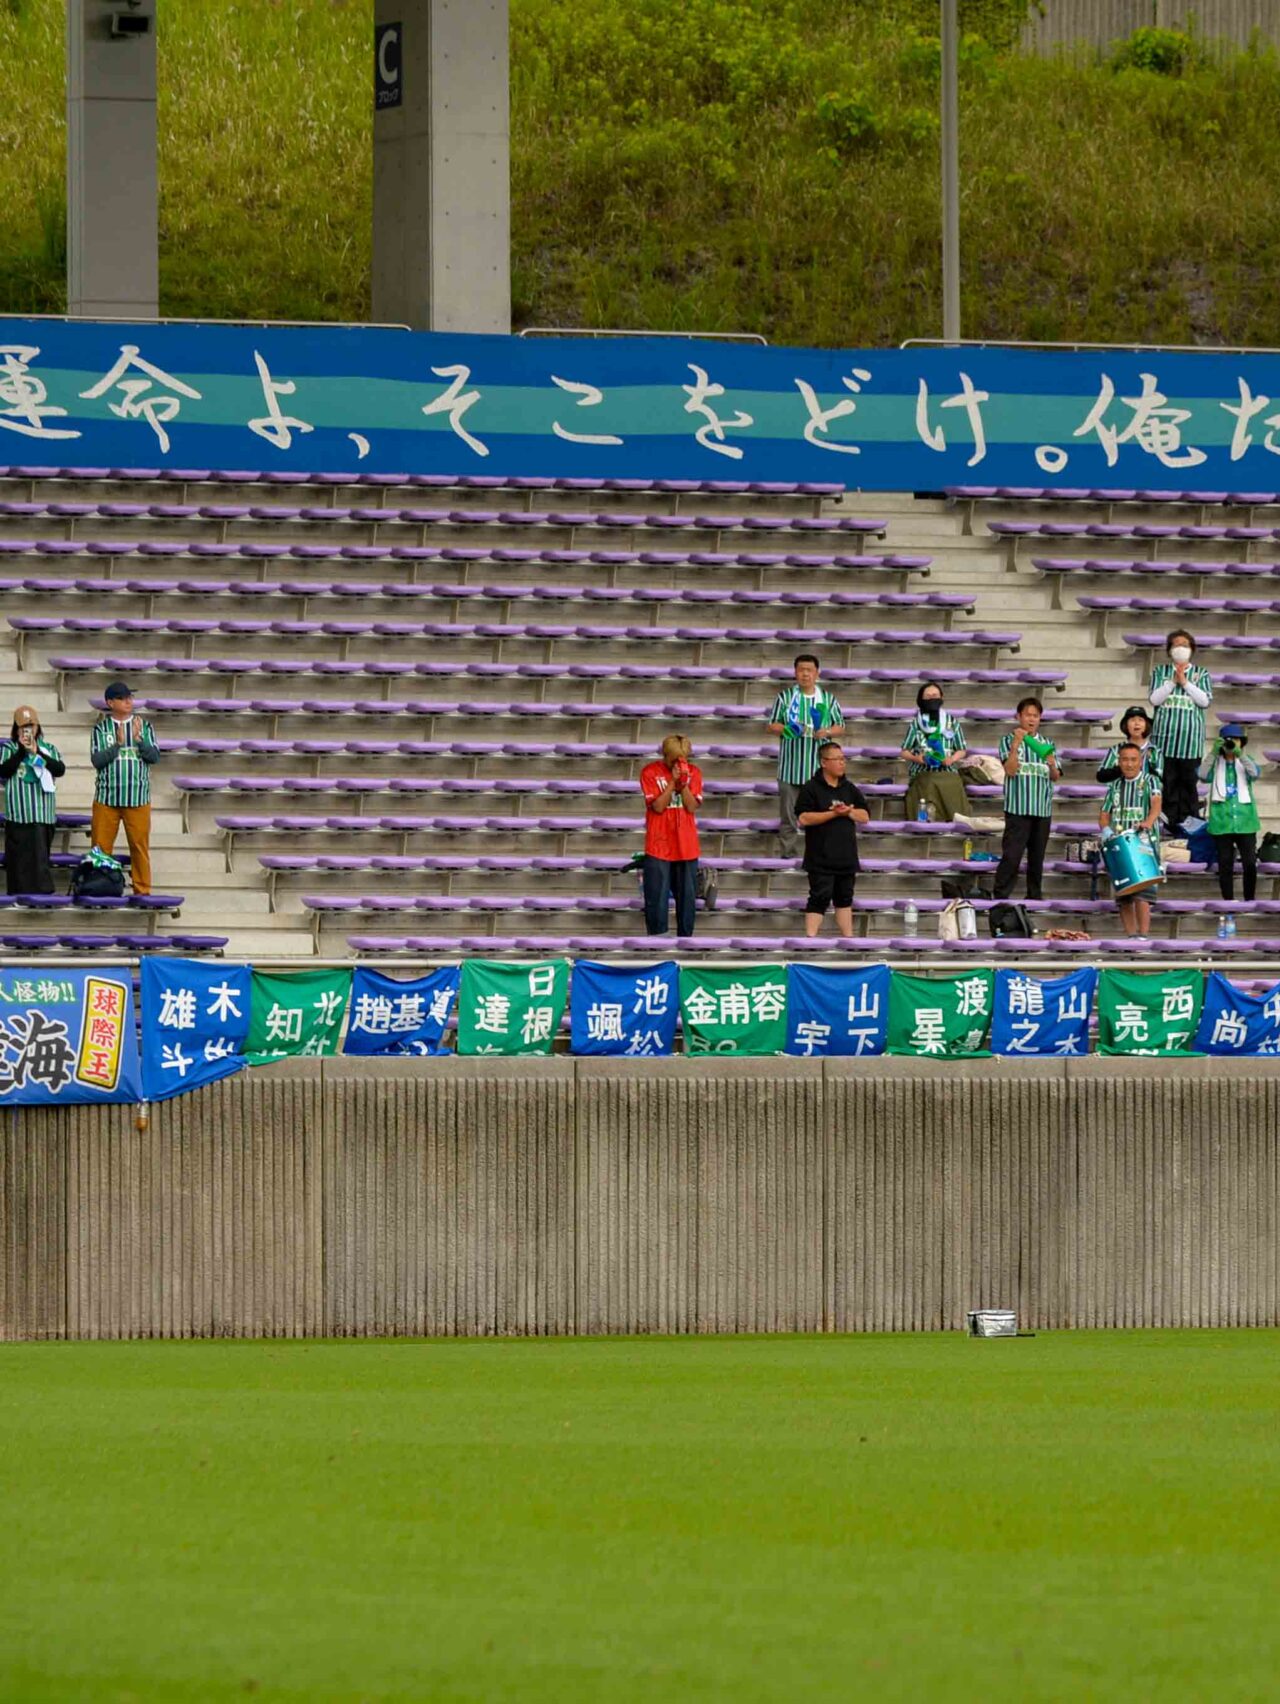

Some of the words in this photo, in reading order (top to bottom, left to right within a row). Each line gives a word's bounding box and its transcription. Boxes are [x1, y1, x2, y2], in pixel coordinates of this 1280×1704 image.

[84, 988, 119, 1081] 球際王
[158, 988, 197, 1077] 雄斗
[473, 992, 511, 1055] 達
[520, 965, 556, 1055] 日根
[684, 981, 786, 1025] 金甫容
[794, 1019, 832, 1056] 宇
[847, 982, 879, 1056] 山下
[1005, 976, 1045, 1053] 龍之
[1209, 1009, 1248, 1048] 尚
